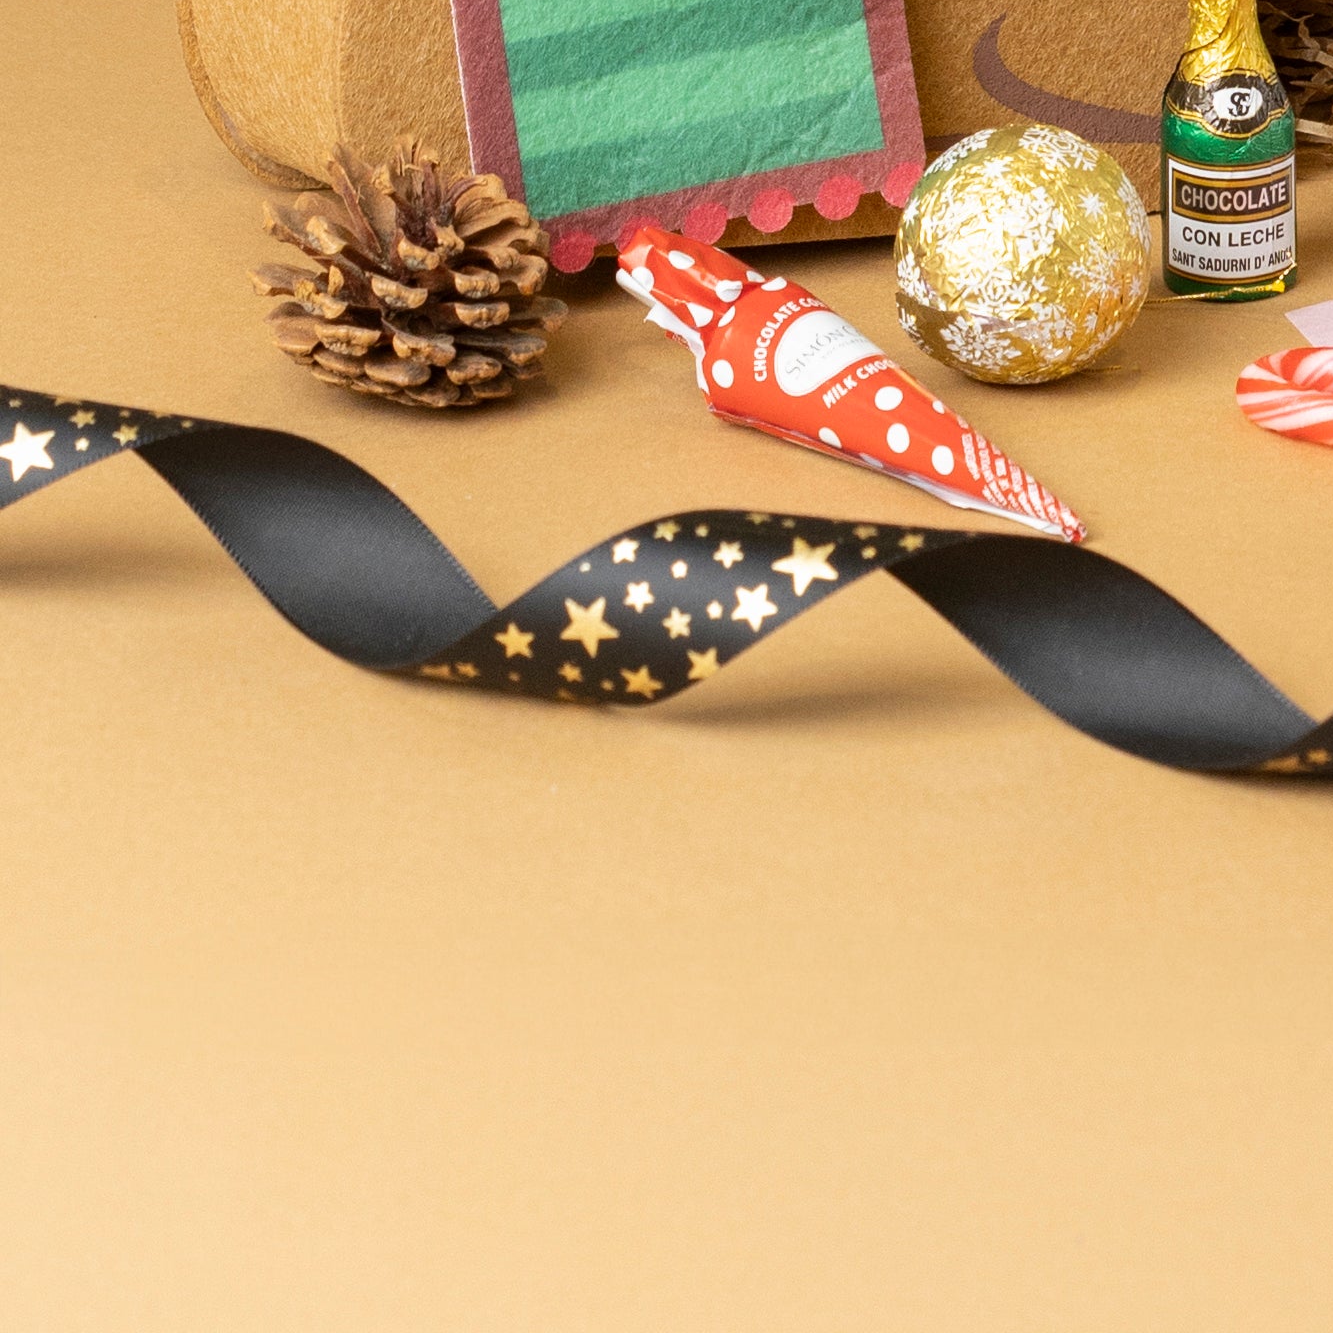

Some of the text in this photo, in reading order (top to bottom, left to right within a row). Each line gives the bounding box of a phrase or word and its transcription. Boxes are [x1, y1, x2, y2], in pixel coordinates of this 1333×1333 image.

[1181, 181, 1287, 211] CHOCOLATE
[1182, 223, 1285, 247] CON LECHE
[1172, 248, 1195, 269] SANT
[1199, 256, 1250, 272] SADURNI
[754, 300, 801, 382] CHOCOLATE
[822, 375, 858, 409] MILK
